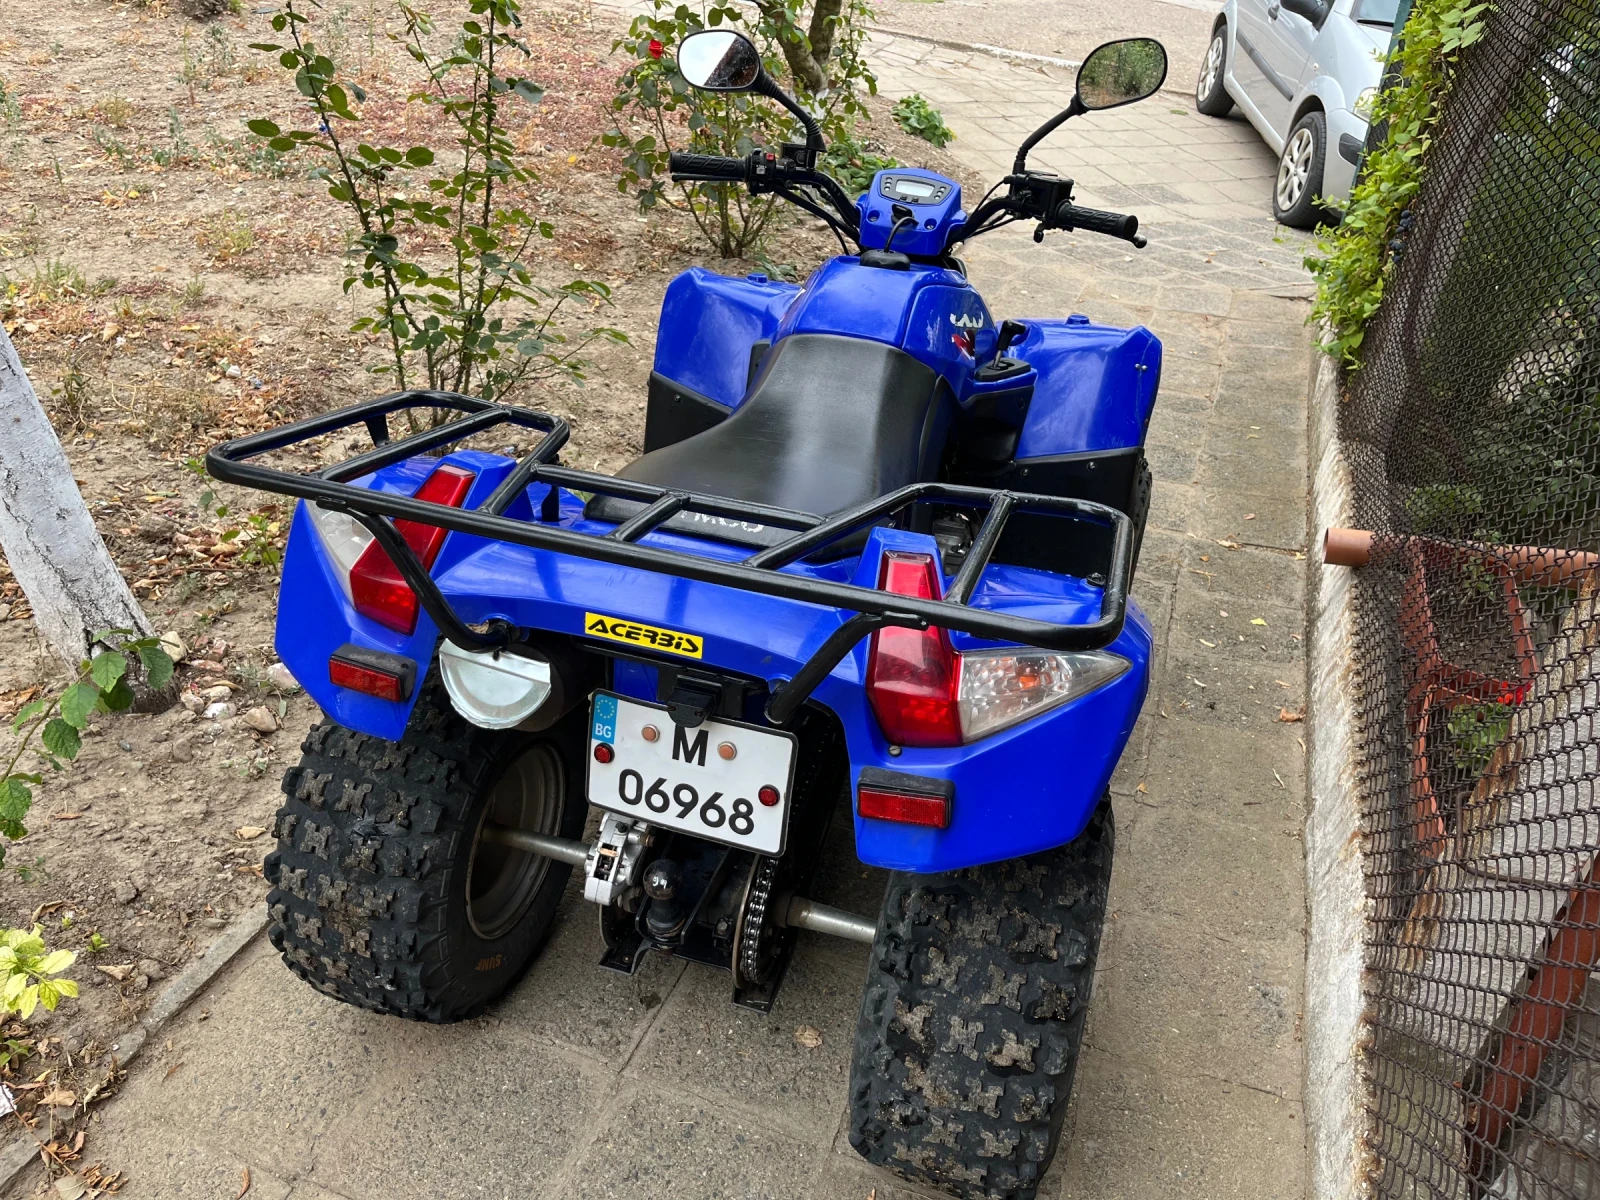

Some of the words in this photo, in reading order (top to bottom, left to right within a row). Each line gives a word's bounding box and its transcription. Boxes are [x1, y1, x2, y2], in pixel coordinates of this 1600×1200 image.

[595, 722, 612, 739] BG
[671, 723, 709, 767] M
[618, 768, 755, 836] 06968
